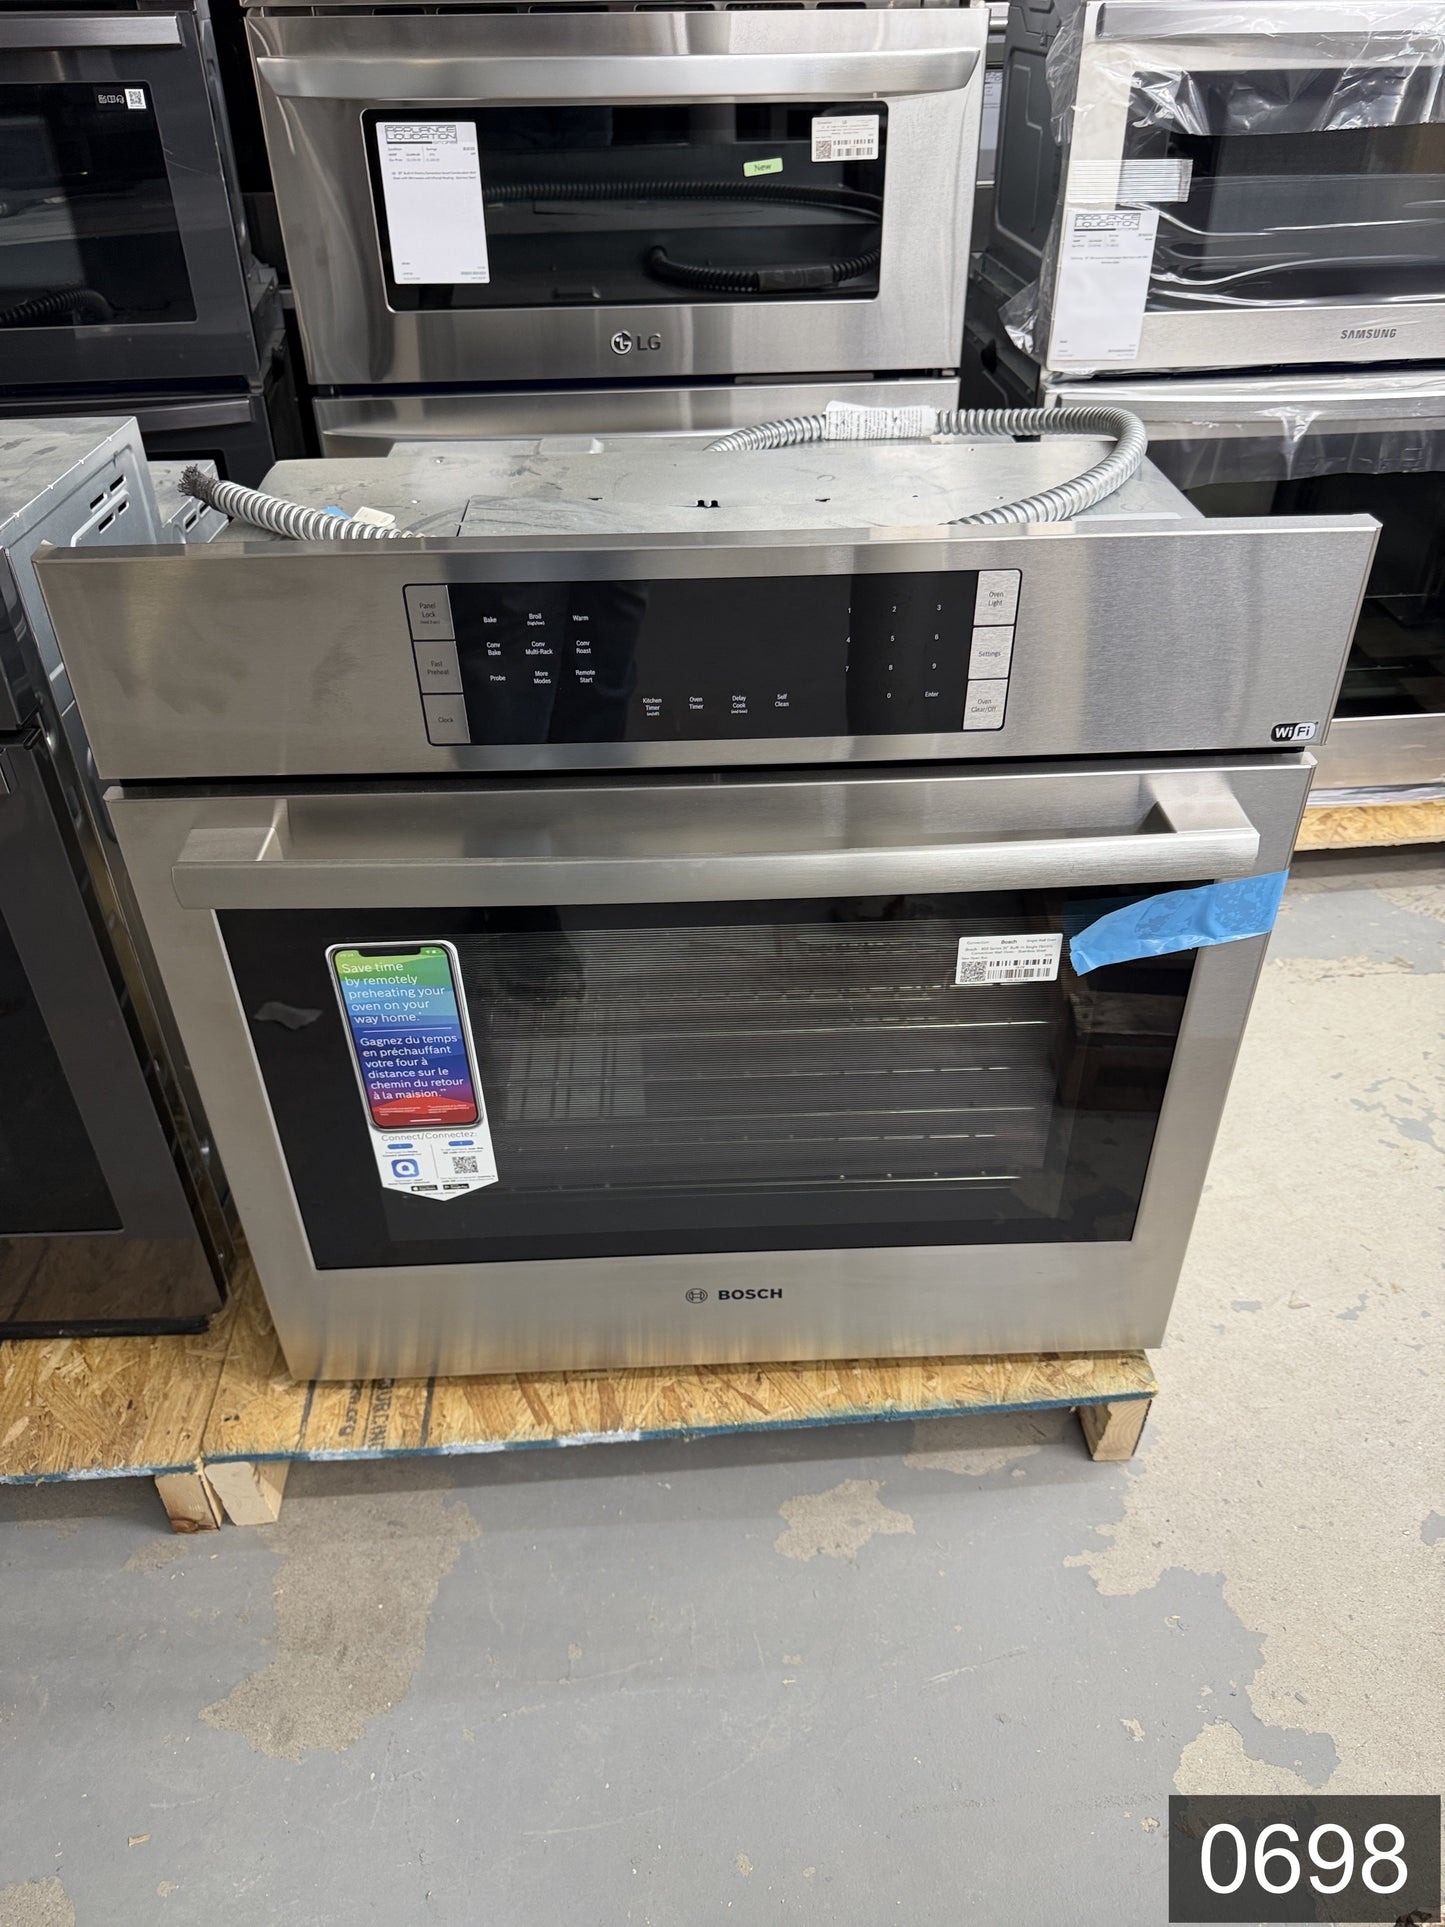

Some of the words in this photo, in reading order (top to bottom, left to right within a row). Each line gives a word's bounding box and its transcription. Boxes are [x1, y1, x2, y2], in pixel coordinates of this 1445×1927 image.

[754, 163, 772, 172] New
[1340, 328, 1397, 340] SAMSUNG
[636, 332, 662, 352] LG
[419, 602, 436, 610] Panel
[988, 600, 1003, 608] Light
[422, 610, 436, 618] Lock
[572, 614, 589, 622] Warm
[978, 650, 1001, 658] Settings
[427, 668, 449, 676] Preheat
[438, 716, 453, 724] Clock
[341, 962, 373, 974] Save
[374, 962, 404, 972] time
[344, 976, 360, 988] by
[363, 974, 418, 986] remotely
[348, 988, 415, 1001] preheating
[418, 986, 446, 998] your
[352, 1002, 381, 1012] oven
[384, 1002, 400, 1010] on
[402, 1000, 430, 1012] your
[354, 1016, 379, 1026] way
[360, 1037, 403, 1048] Gagnez
[405, 1036, 420, 1044] du
[422, 1034, 458, 1045] temps
[362, 1050, 378, 1058] en
[380, 1045, 452, 1060] préchauffant
[365, 1060, 394, 1068] votre
[395, 1057, 418, 1066] four
[421, 1057, 429, 1066] à
[368, 1069, 416, 1079] distance
[418, 1069, 435, 1078] sur
[438, 1067, 449, 1076] le
[371, 1080, 412, 1090] chemin
[413, 1079, 428, 1088] du
[430, 1078, 464, 1086] retour
[373, 1092, 381, 1100] à
[382, 1091, 394, 1100] la
[718, 1288, 783, 1301] BOSCH
